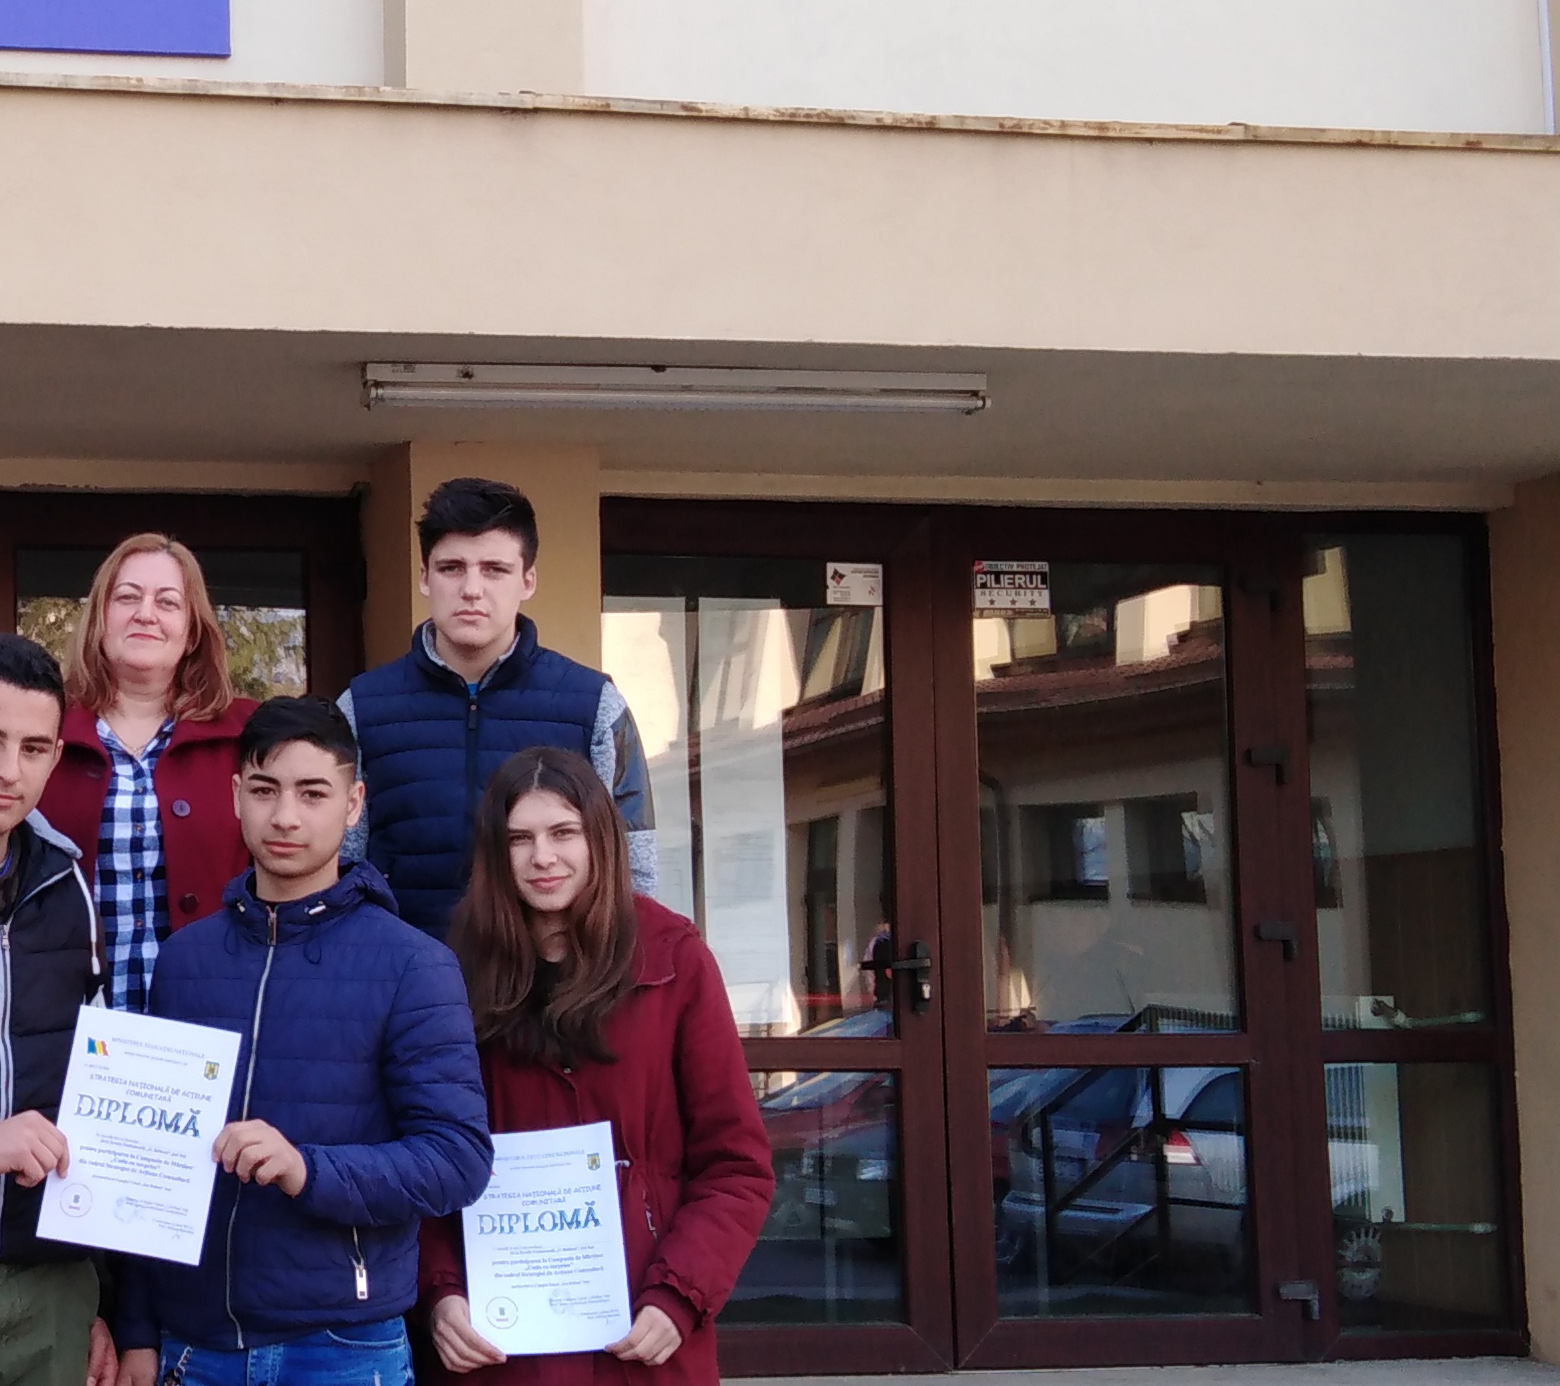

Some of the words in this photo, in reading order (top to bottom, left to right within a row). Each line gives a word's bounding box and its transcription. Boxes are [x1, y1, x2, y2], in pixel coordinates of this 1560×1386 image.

[976, 573, 1047, 589] PILIERUL
[980, 589, 1043, 597] SECURITY
[74, 1093, 201, 1138] DIPLOMĂ
[477, 1200, 601, 1235] DIPLOMĂ
